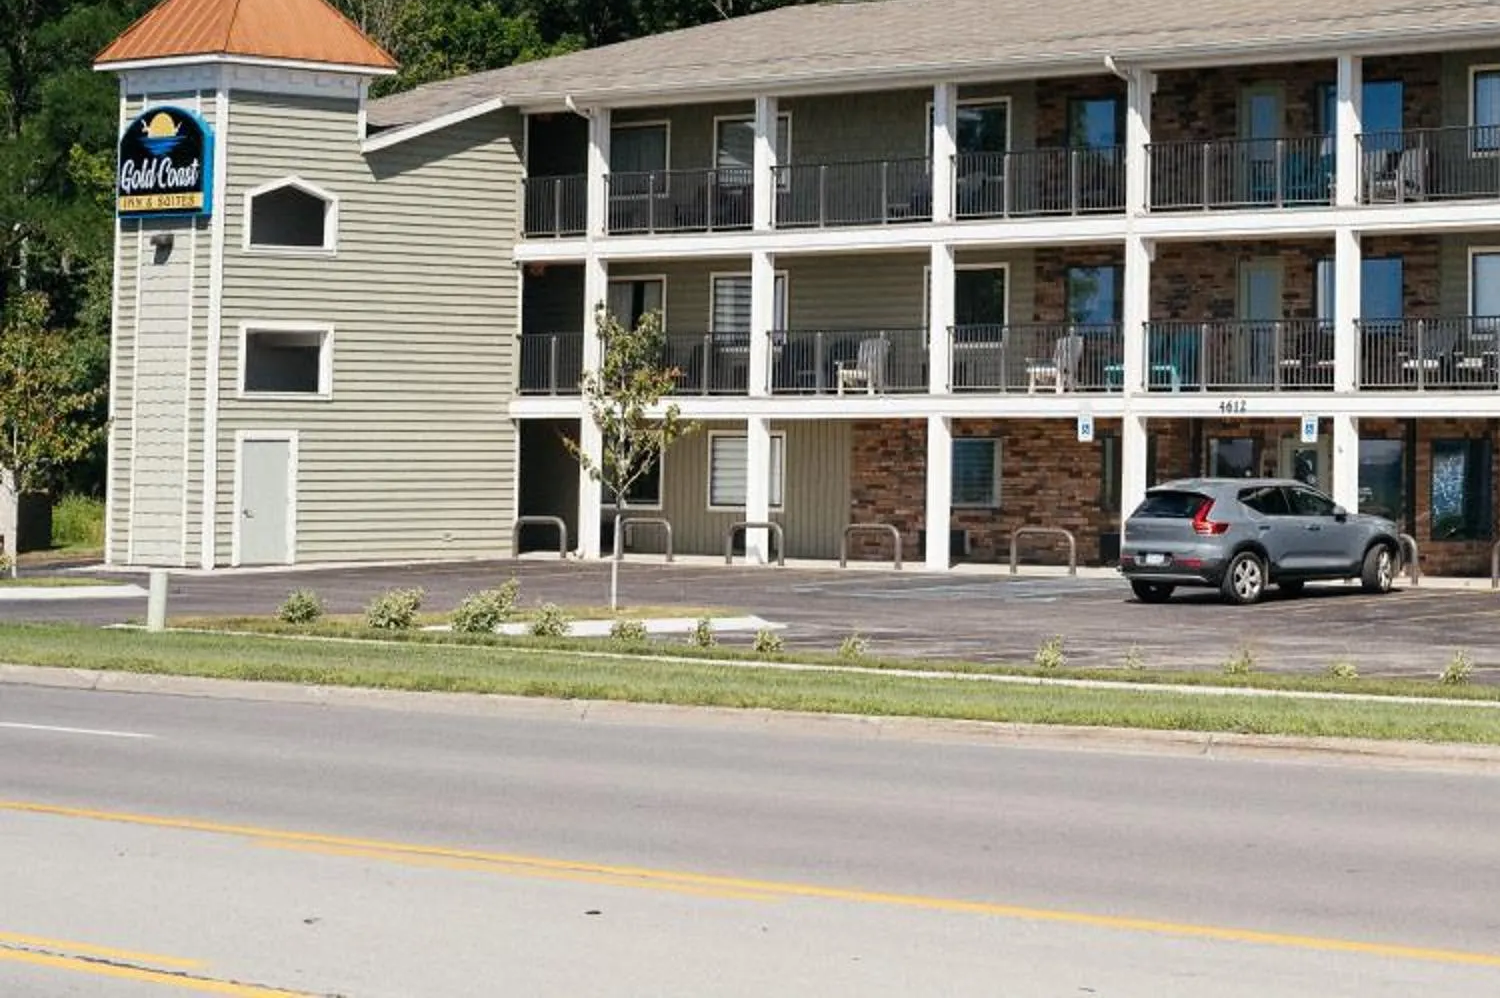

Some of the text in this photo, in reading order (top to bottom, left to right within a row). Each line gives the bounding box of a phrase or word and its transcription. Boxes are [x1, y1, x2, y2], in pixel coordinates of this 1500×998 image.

[121, 156, 200, 194] Gold Coast
[1219, 399, 1247, 414] 4612
